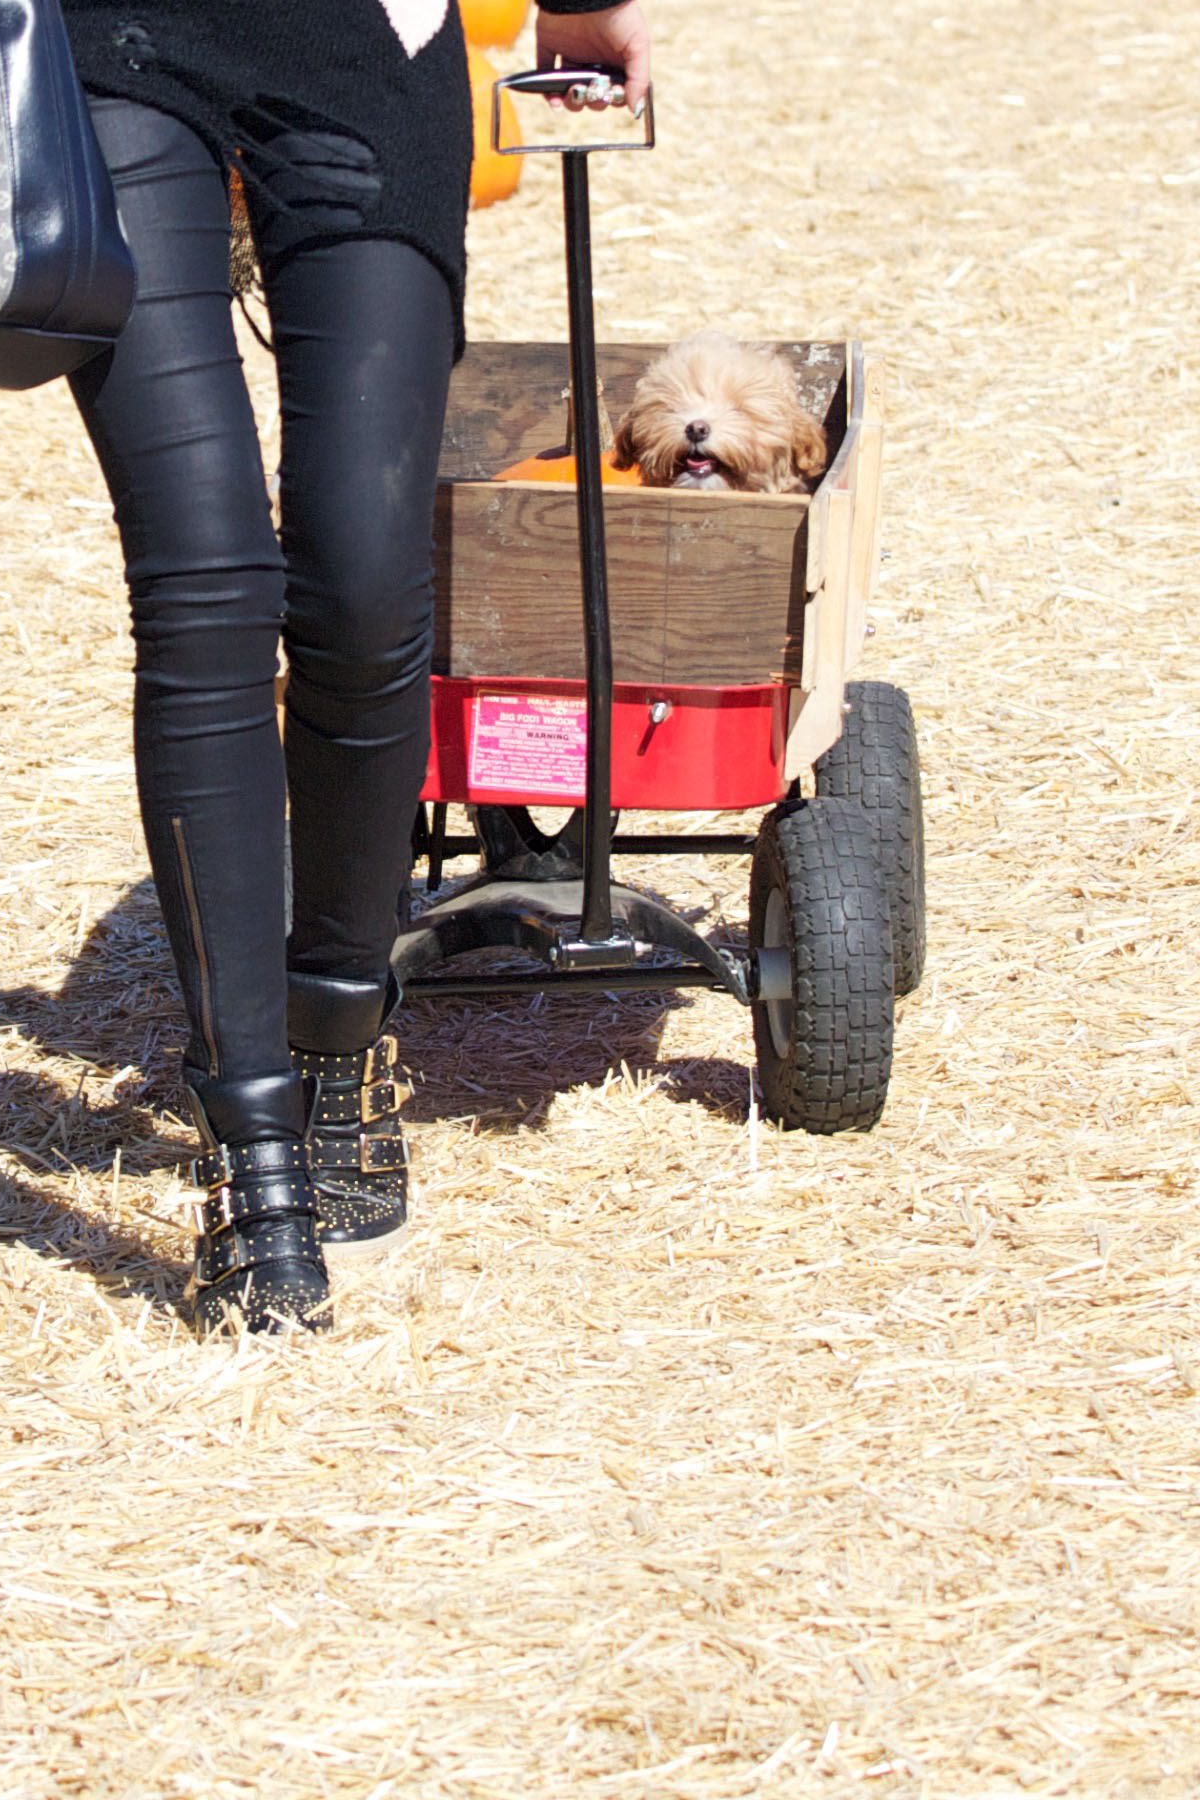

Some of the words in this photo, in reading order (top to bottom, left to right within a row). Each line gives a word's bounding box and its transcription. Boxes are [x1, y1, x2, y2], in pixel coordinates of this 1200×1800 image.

[527, 697, 587, 708] HAUL-MASTE
[500, 712, 515, 721] BIG
[517, 713, 539, 723] FOOT
[543, 715, 577, 726] WAGON
[527, 731, 569, 741] WARNING
